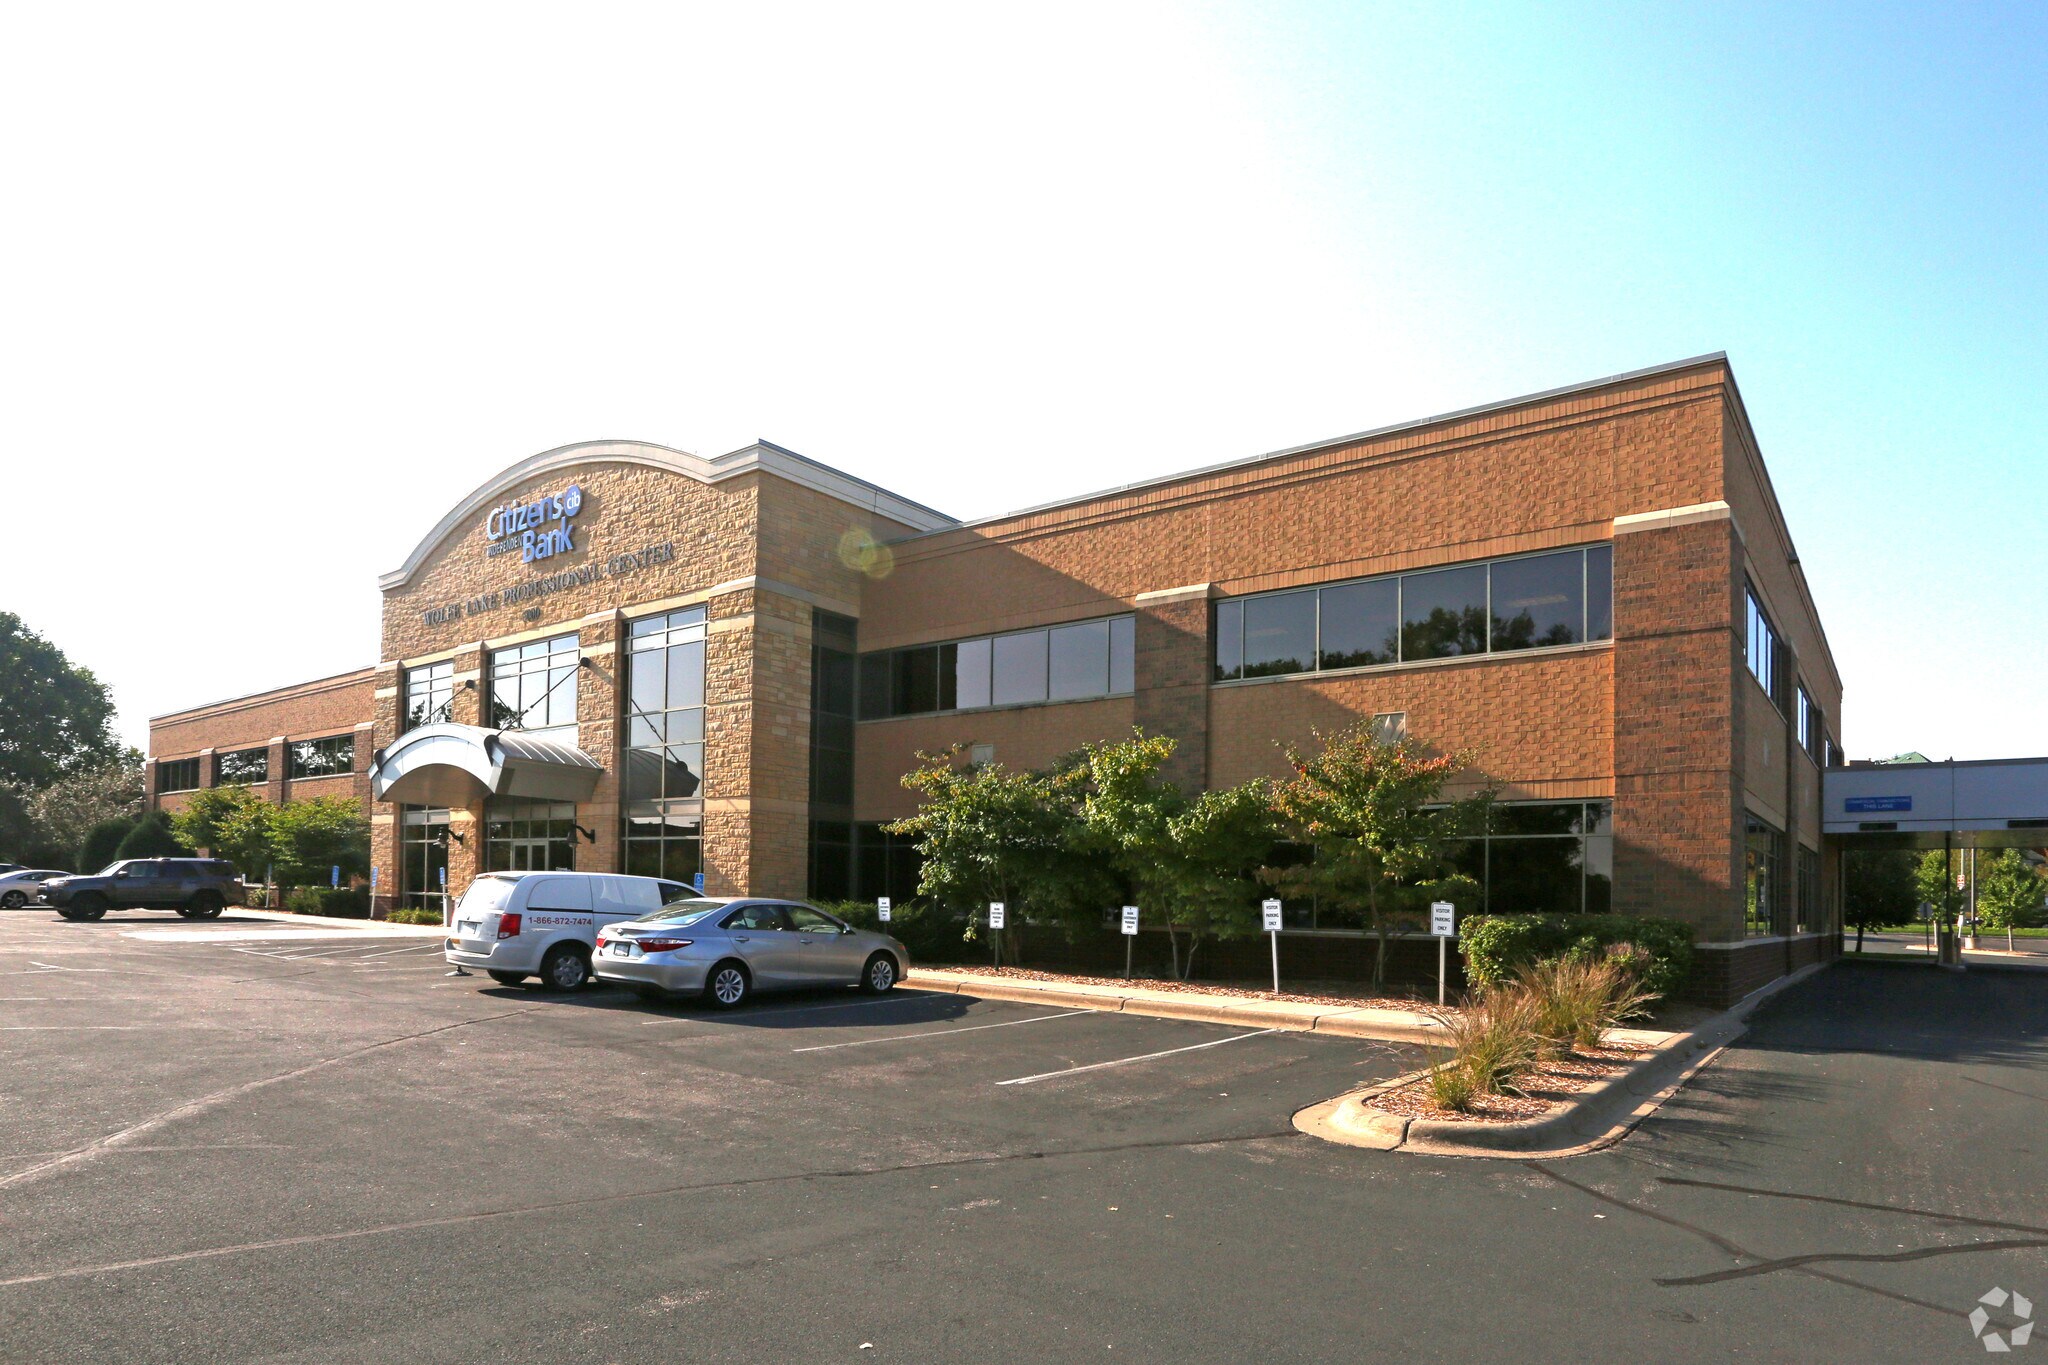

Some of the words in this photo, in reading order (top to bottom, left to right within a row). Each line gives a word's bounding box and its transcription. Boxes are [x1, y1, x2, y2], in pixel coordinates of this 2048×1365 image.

[487, 491, 565, 541] Citizens
[566, 491, 581, 509] cib
[487, 534, 524, 557] INDEPENDEN
[522, 516, 574, 564] Bank
[423, 603, 461, 626] WOLFE
[466, 591, 499, 615] LAKE
[503, 562, 603, 605] PROFESSIONAL
[605, 541, 673, 576] CENTER
[528, 916, 593, 926] 1-866-872-7474
